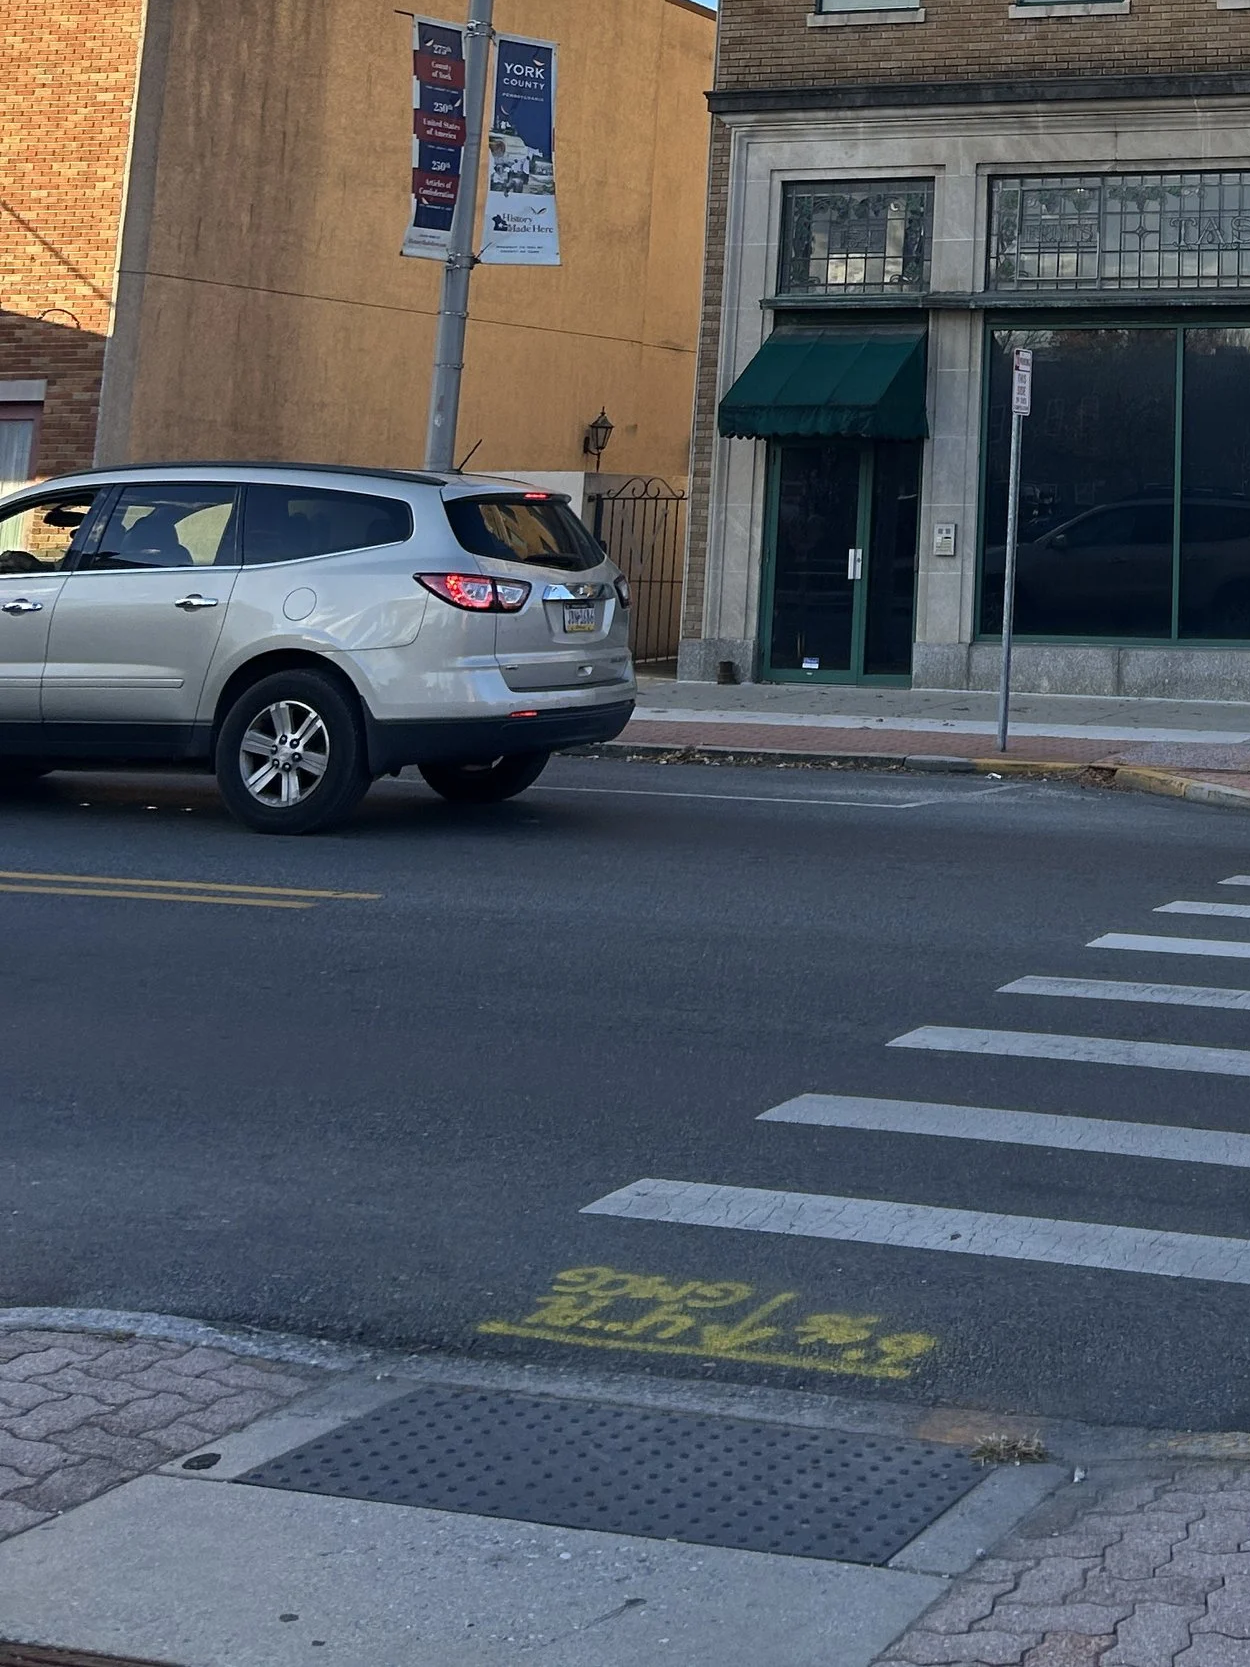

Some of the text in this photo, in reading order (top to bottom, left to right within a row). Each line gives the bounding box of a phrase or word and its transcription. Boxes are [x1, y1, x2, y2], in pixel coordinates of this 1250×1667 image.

[504, 62, 545, 80] YORK
[503, 77, 545, 90] COUNTY
[422, 118, 461, 131] United States
[502, 213, 532, 224] History
[532, 224, 554, 234] Here
